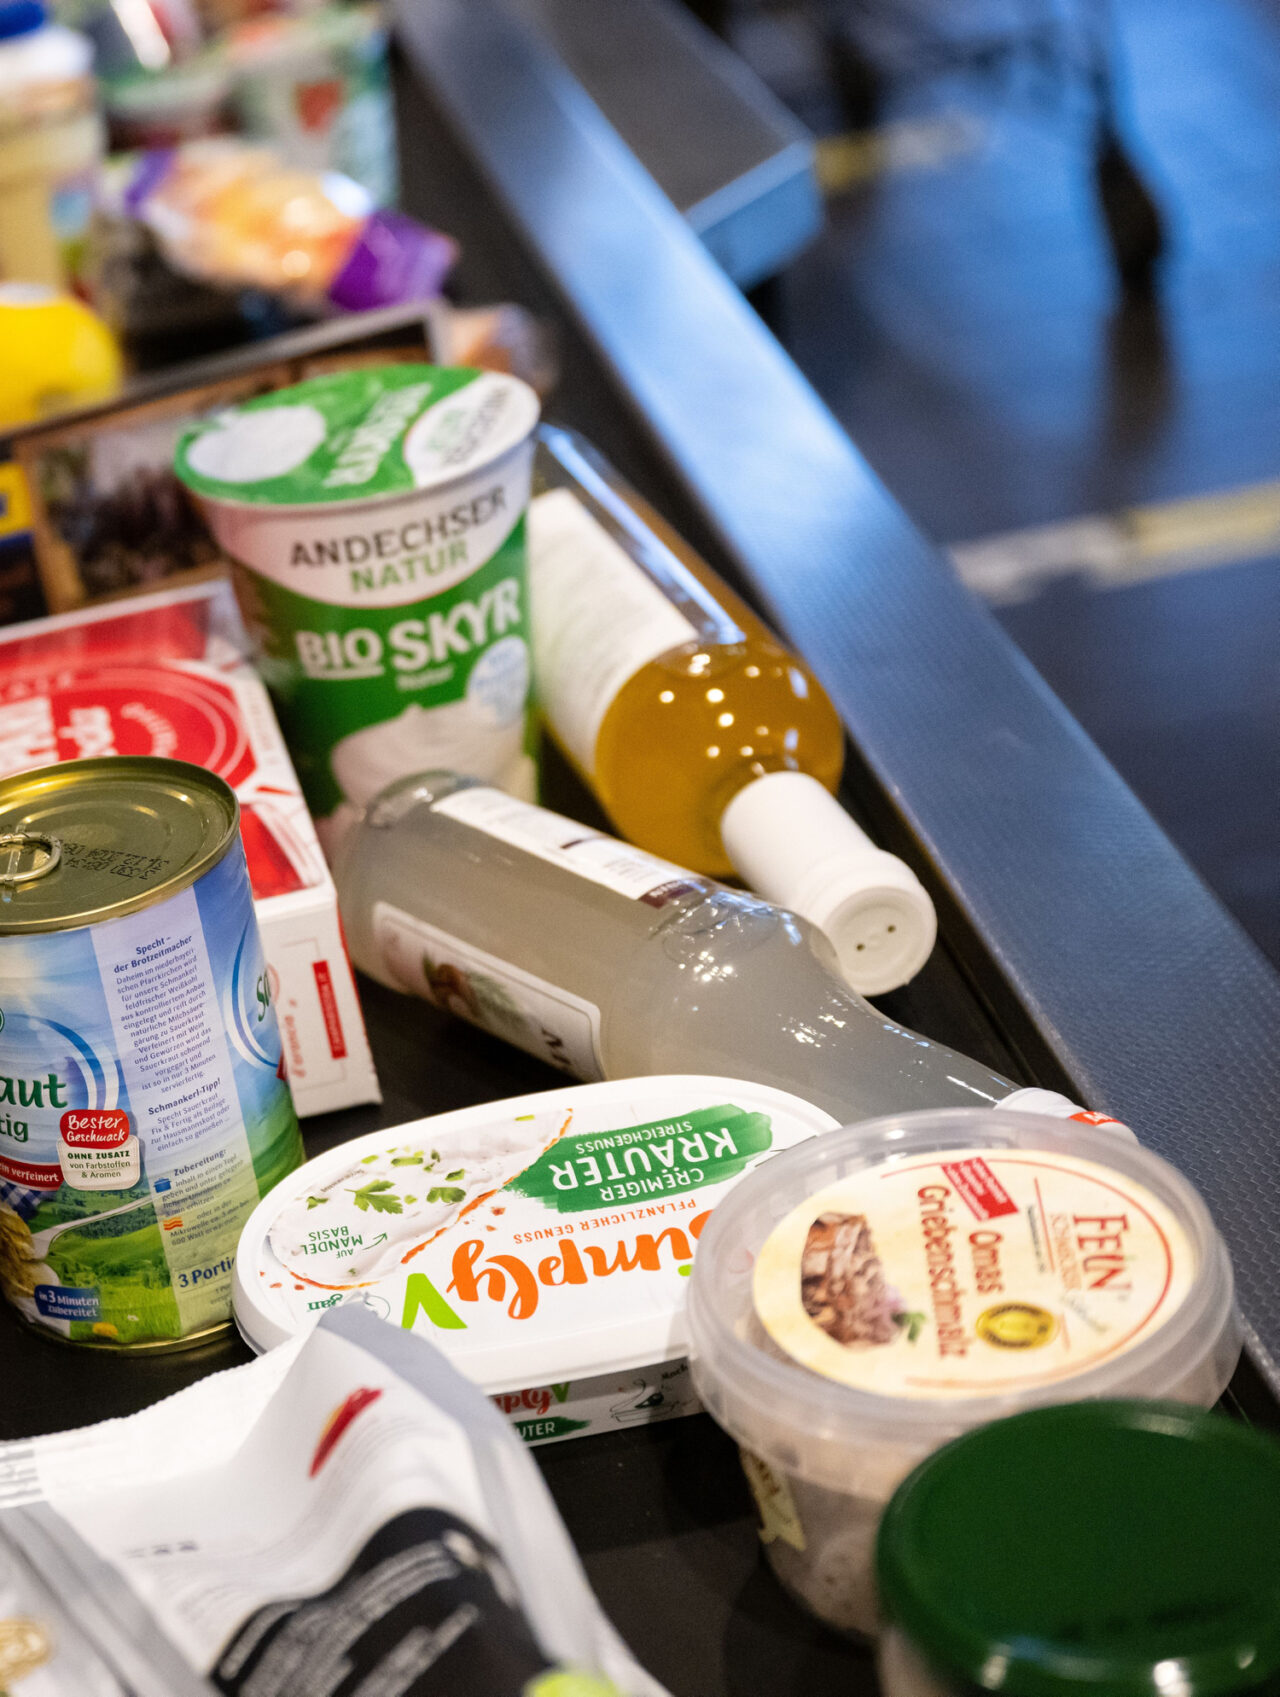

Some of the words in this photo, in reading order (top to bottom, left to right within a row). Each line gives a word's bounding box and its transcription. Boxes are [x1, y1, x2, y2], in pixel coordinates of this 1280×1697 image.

[290, 486, 507, 567] ANDECHSER
[350, 541, 467, 593] NATUR
[296, 628, 384, 668] BIO
[389, 577, 520, 671] SKYR
[113, 964, 128, 973] der
[131, 936, 192, 968] Brotzeitmacher
[135, 937, 165, 954] Specht
[116, 971, 142, 984] Daheim
[121, 993, 131, 1001] für
[134, 985, 158, 998] unsere
[125, 991, 166, 1010] feldfrischer
[120, 1013, 133, 1021] aus
[134, 993, 184, 1016] kontrolliertem
[123, 1012, 157, 1029] eingelegt
[148, 1077, 221, 1115] Schmankerl-Tipp!
[68, 1115, 124, 1130] Bester
[66, 1129, 126, 1144] Geschmack
[575, 1120, 693, 1155] STREICHGENUSS
[67, 1152, 91, 1160] OHNE
[95, 1150, 131, 1160] ZUSATZ
[69, 1162, 83, 1170] von
[85, 1159, 132, 1170] Farbstoffen
[548, 1127, 738, 1191] KRÄUTER
[90, 1170, 122, 1179] Aromen
[599, 1167, 705, 1202] CREMIGER
[580, 1199, 697, 1232] PFLANZLICHER
[309, 1225, 349, 1243] BASIS
[513, 1223, 574, 1245] GENUSS
[300, 1235, 363, 1256] MANDEL
[336, 1248, 354, 1259] AUF
[969, 1230, 1004, 1294] Omas
[177, 1273, 190, 1289] 3
[401, 1272, 468, 1329] V
